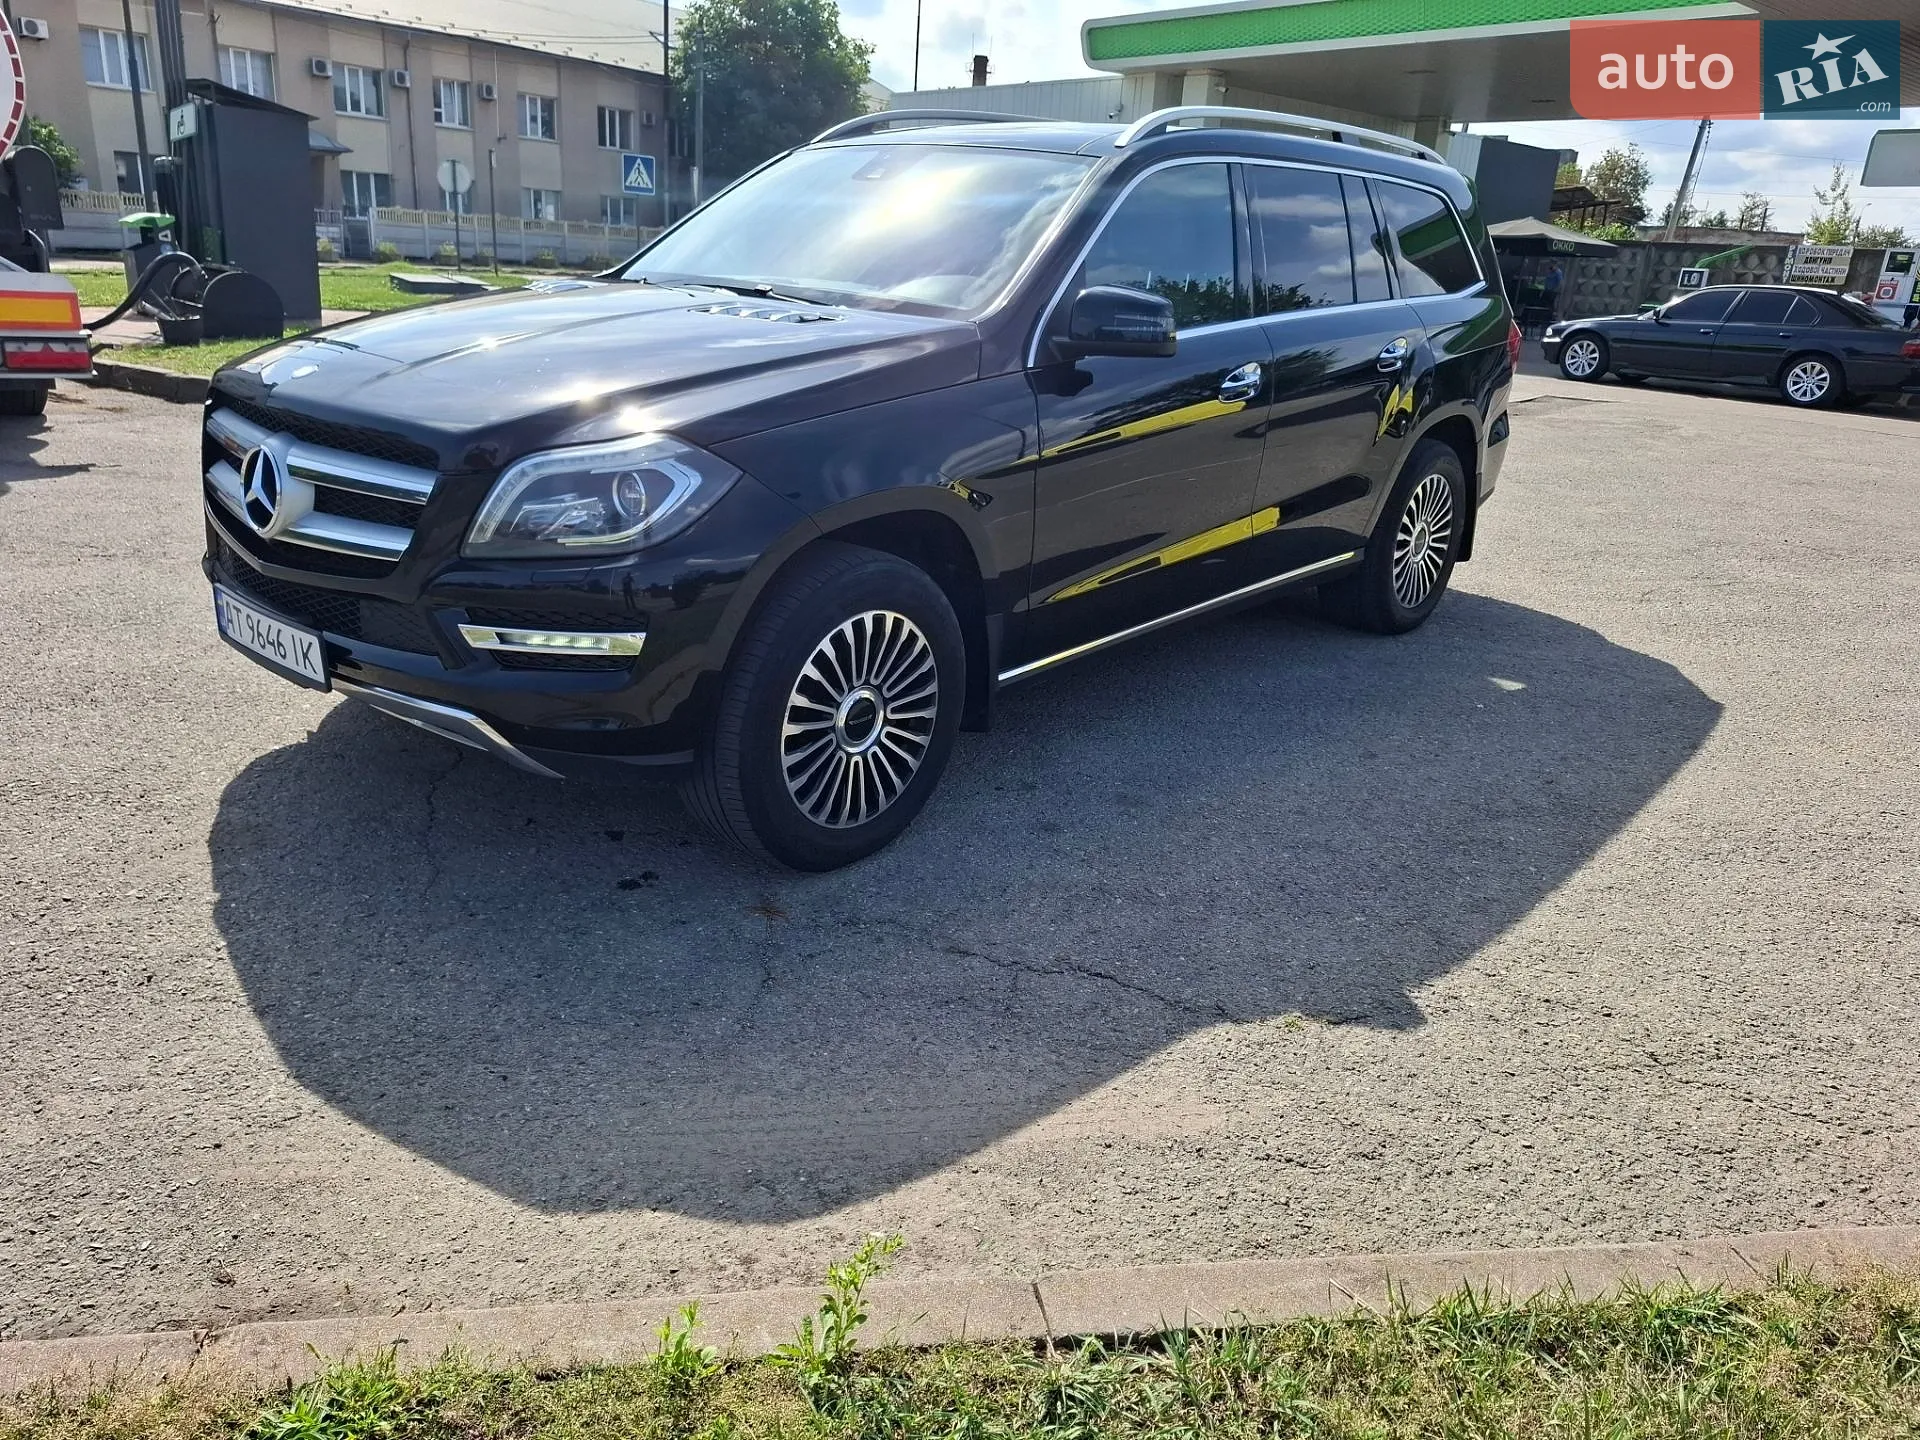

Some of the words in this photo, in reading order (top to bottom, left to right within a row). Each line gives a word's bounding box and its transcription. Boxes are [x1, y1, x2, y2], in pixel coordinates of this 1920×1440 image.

[1552, 240, 1575, 252] OKKO
[225, 600, 242, 639] AT
[246, 614, 287, 661] 9646
[291, 633, 318, 675] IK
